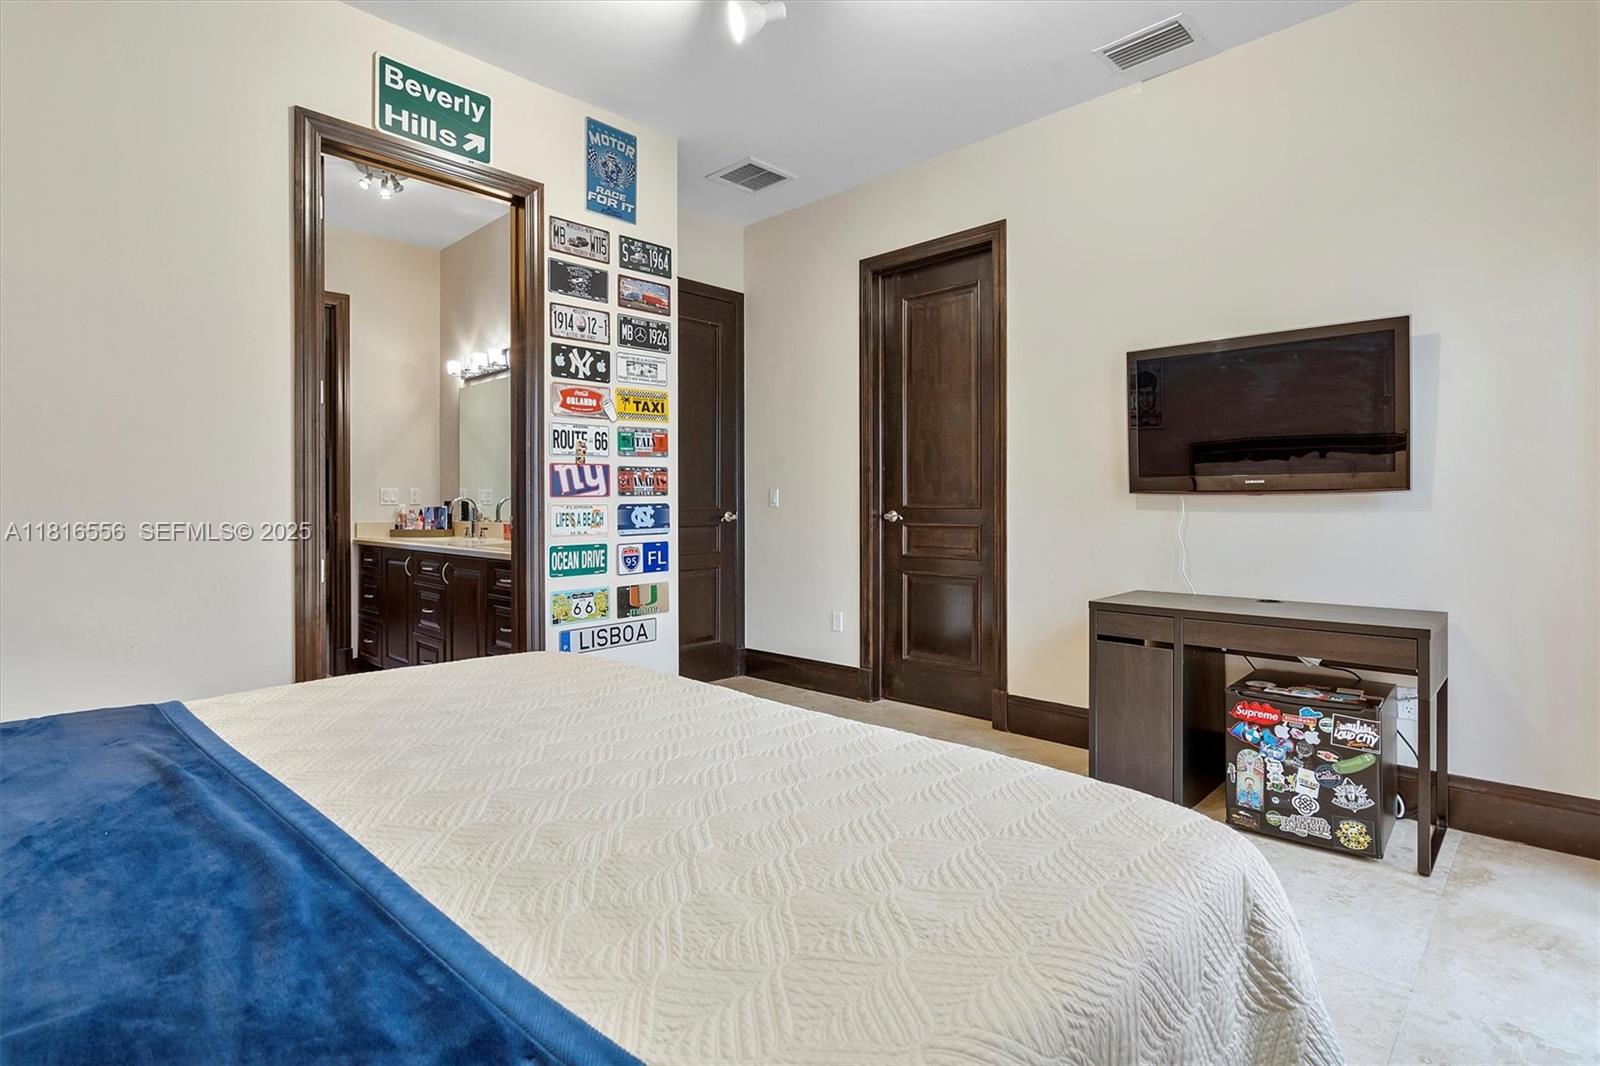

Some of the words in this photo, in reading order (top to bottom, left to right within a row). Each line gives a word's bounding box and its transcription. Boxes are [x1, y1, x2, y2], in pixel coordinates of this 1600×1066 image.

[384, 64, 485, 123] Beverly
[384, 103, 457, 147] Hills
[588, 130, 636, 159] MOTOR
[588, 191, 617, 209] FOR
[621, 202, 635, 213] IT
[596, 186, 626, 202] RACE
[553, 224, 566, 245] MB
[622, 243, 629, 262] S
[649, 249, 669, 272] 1964
[553, 310, 574, 331] 1914
[621, 323, 634, 341] MB
[649, 328, 668, 346] 1926
[566, 396, 597, 407] ORLANDO
[633, 400, 665, 413] TAXI
[553, 429, 588, 449] ROUTE
[594, 431, 608, 451] 66
[631, 437, 656, 448] ITALY
[626, 477, 660, 487] CANADA
[576, 512, 582, 527] A
[583, 512, 604, 527] BEACH
[552, 550, 579, 571] OCEAN
[581, 549, 605, 569] DRIVE
[625, 557, 637, 567] 95
[648, 550, 667, 565] FL
[579, 623, 648, 650] LISBOA
[1236, 705, 1279, 721] Supreme
